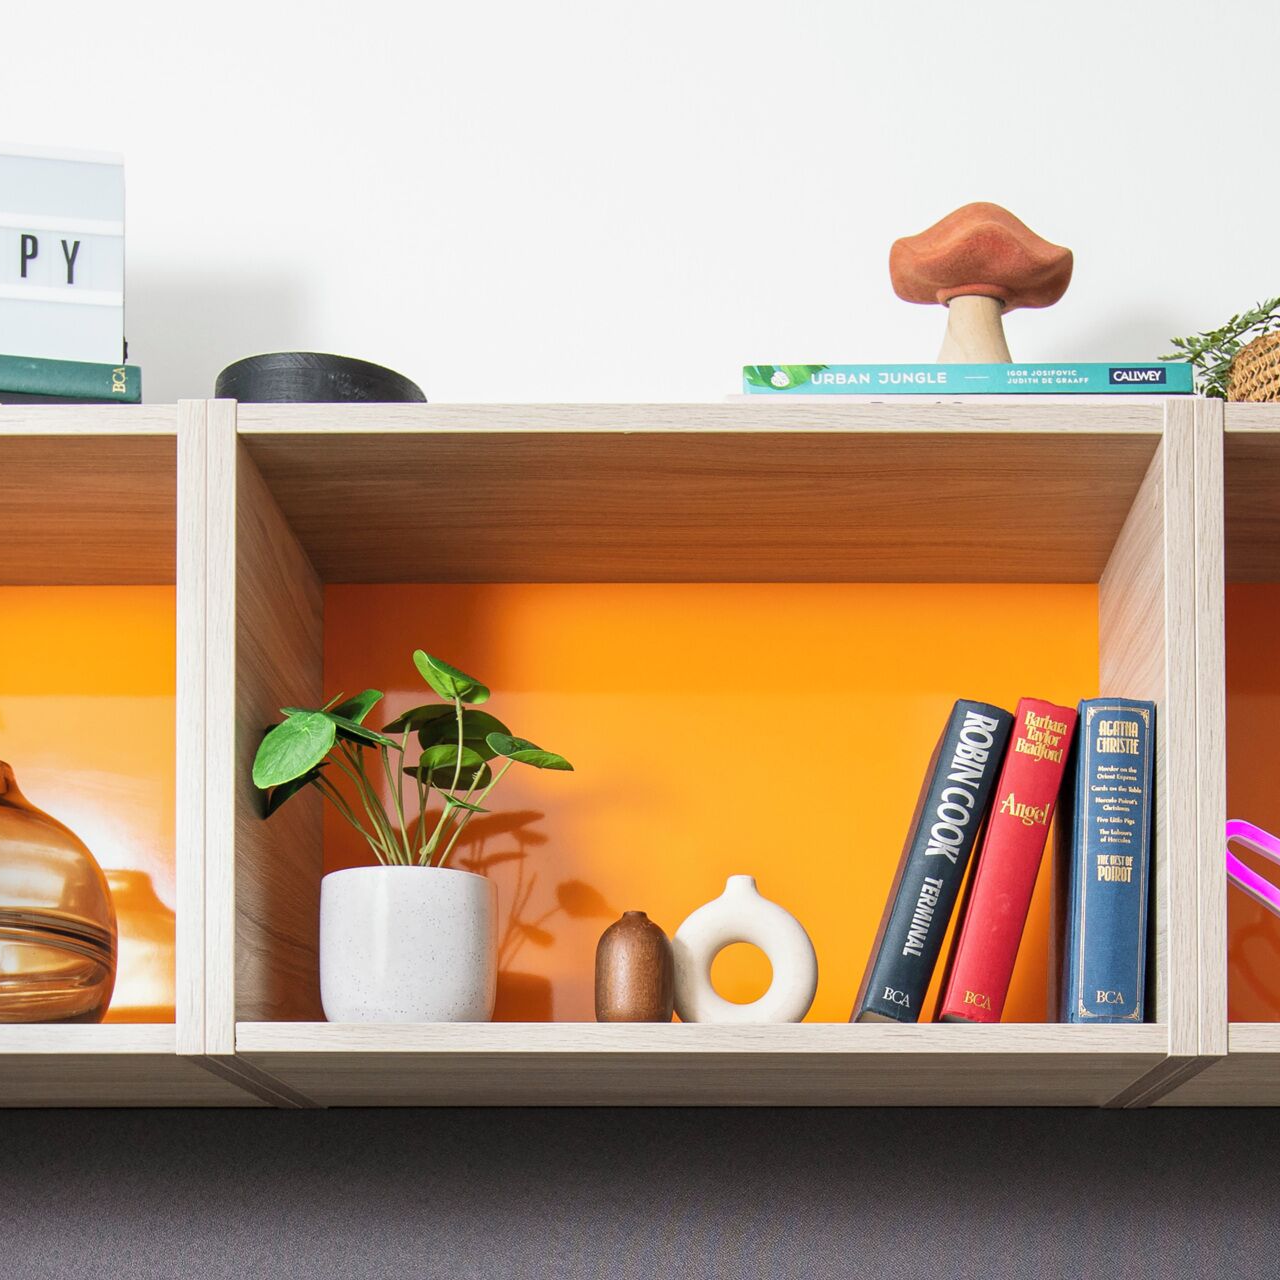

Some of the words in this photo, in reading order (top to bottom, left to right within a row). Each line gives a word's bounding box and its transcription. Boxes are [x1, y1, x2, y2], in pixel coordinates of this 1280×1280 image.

[112, 367, 126, 393] BCA
[811, 373, 871, 385] URBAN
[878, 371, 948, 384] JUNGLE
[1113, 370, 1162, 382] CALLWEY
[1024, 710, 1068, 735] Barbara
[1099, 720, 1138, 737] AGATHA
[1026, 725, 1061, 747] Taylor
[1096, 736, 1140, 755] CHRISTIE
[947, 710, 999, 789] ROBIN
[1015, 737, 1064, 763] Bradford
[999, 792, 1051, 826] Angel
[924, 786, 976, 864] COOK
[1097, 854, 1110, 865] THE
[1110, 855, 1125, 866] BEST
[1125, 855, 1134, 866] OF
[1097, 865, 1133, 883] POIROT
[902, 876, 943, 957] TERMINAL
[882, 986, 910, 1008] BCA
[963, 990, 991, 1012] BCA
[1096, 990, 1124, 1004] BCA
